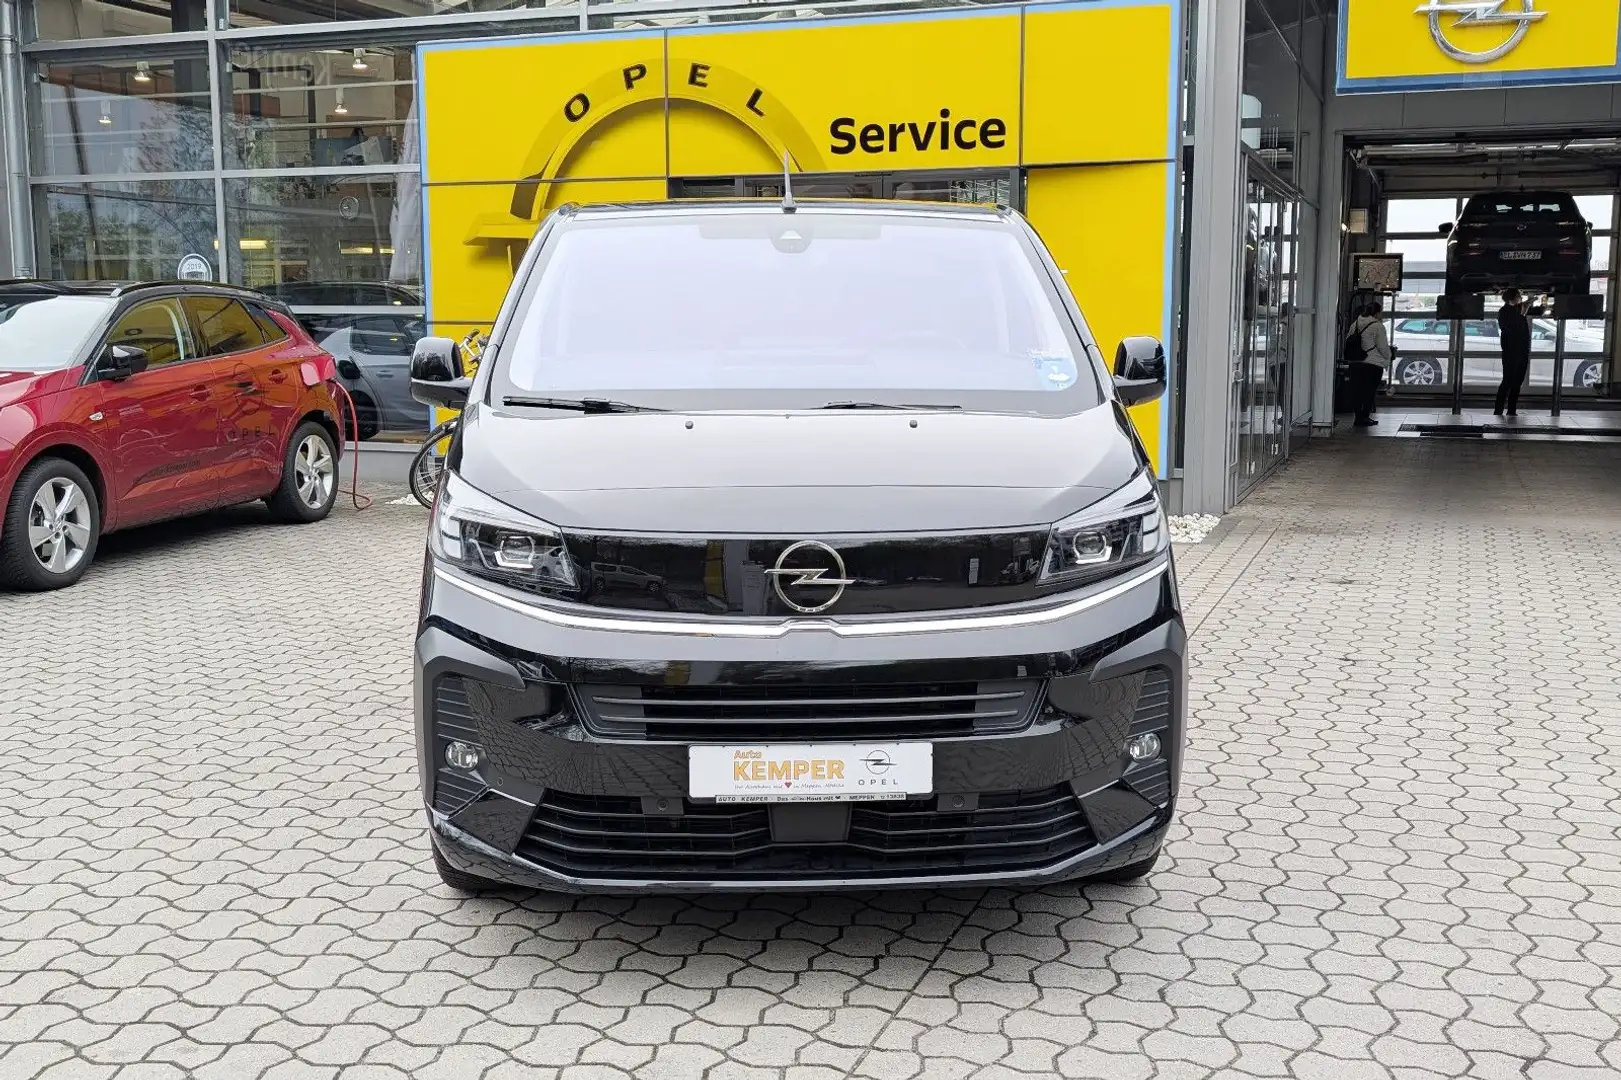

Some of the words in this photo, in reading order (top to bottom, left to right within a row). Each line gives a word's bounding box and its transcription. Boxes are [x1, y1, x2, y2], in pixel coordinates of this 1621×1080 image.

[563, 62, 768, 123] OPEL
[829, 108, 1006, 155] Service
[734, 750, 762, 759] Auto
[734, 760, 845, 780] KEMPER
